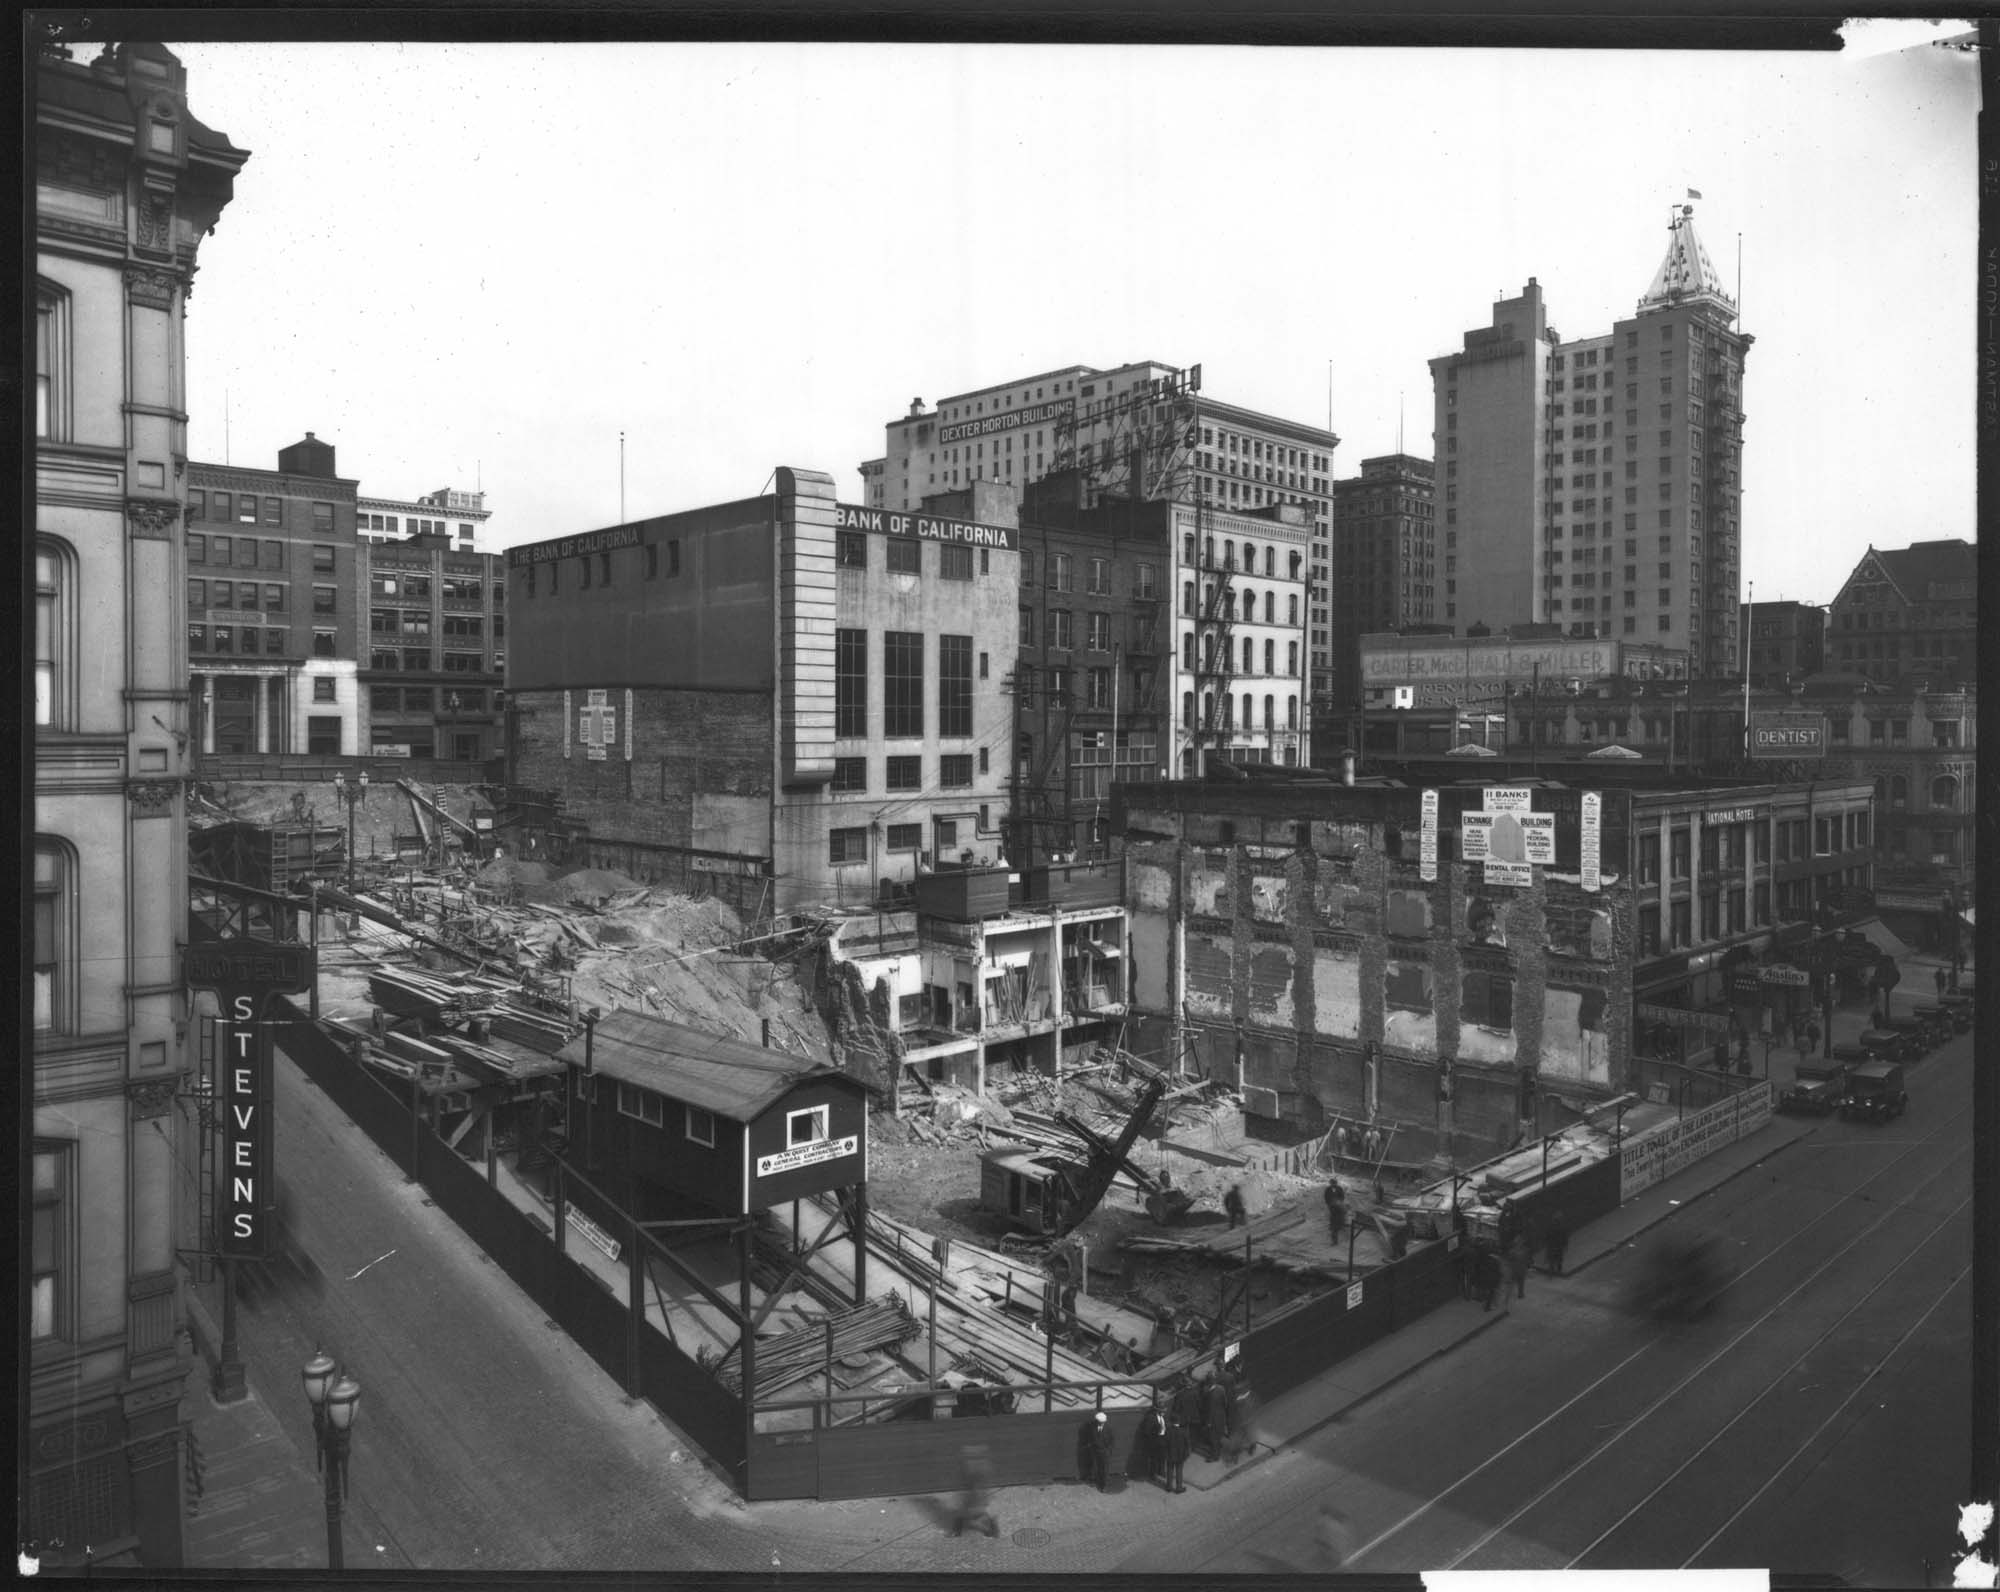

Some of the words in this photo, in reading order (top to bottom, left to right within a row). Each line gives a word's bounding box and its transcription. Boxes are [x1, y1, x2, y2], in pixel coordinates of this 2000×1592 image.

[942, 422, 981, 442] DEXTER
[982, 412, 1020, 433] HORTON
[1022, 400, 1073, 424] BUILDING
[836, 508, 882, 531] BANK
[890, 515, 911, 534] OF
[918, 519, 1008, 547] CALIFORNIA
[515, 549, 531, 564] THE
[533, 543, 559, 561] BANK
[561, 541, 575, 556] OF
[577, 527, 639, 553] CALIFORNIA
[1520, 653, 1536, 672] &
[1760, 730, 1816, 743] DENTIST
[1463, 816, 1493, 825] EXCHANGE
[1520, 817, 1552, 826] BUILDING
[233, 996, 254, 1238] STEVENS
